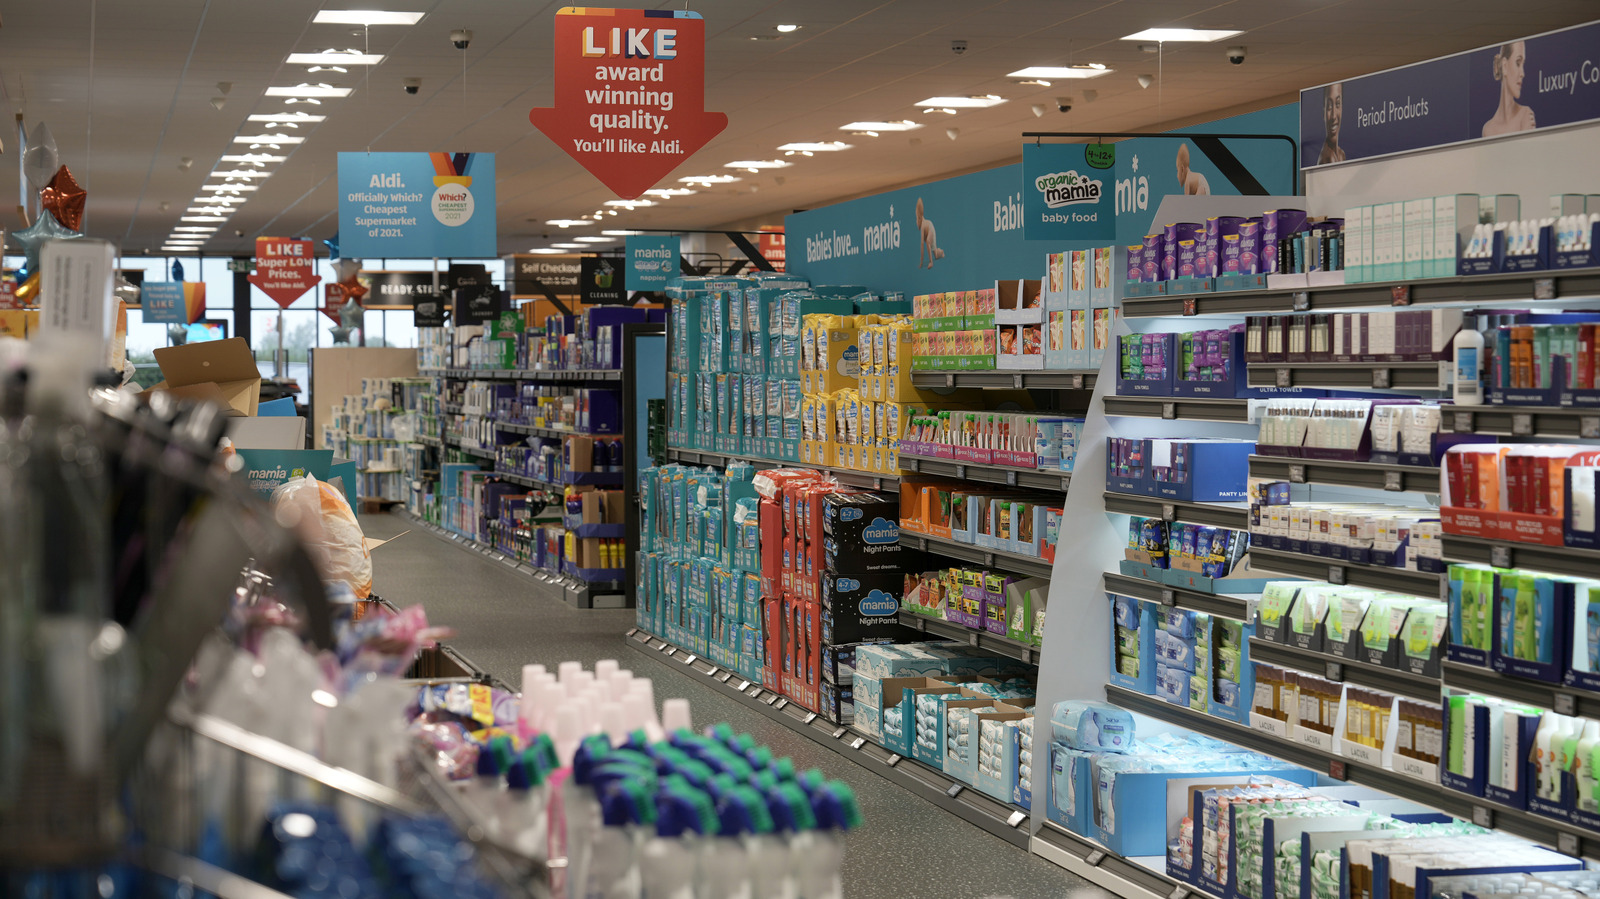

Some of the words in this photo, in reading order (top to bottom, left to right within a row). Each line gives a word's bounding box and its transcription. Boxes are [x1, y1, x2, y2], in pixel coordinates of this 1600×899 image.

[582, 26, 678, 60] LIKE
[595, 63, 664, 82] award
[1539, 69, 1578, 95] Luxury
[1581, 59, 1600, 85] Co
[585, 84, 673, 111] winning
[1357, 101, 1386, 128] Period
[1389, 95, 1429, 123] Products
[589, 109, 669, 135] quality.
[573, 138, 615, 153] You'll
[618, 138, 646, 153] like
[649, 139, 685, 154] Aldi.
[369, 172, 406, 188] Aldi.
[1037, 172, 1078, 191] organic
[1046, 176, 1099, 203] mamia
[348, 192, 389, 204] Officially
[390, 192, 423, 202] Which?
[438, 192, 467, 202] Which?
[364, 204, 408, 216] Cheapest
[444, 212, 461, 220] 2021
[354, 216, 417, 228] Supermarket
[1041, 212, 1070, 224] baby
[1071, 212, 1098, 222] food
[368, 228, 379, 238] of
[379, 228, 404, 238] 2021.
[863, 204, 901, 255] mamia
[266, 243, 304, 257] LIKE
[634, 244, 672, 259] mamia
[806, 231, 832, 263] Babies
[833, 229, 859, 258] love...
[257, 257, 288, 269] Super
[289, 258, 312, 267] LOW
[521, 262, 540, 274] Self
[268, 269, 302, 279] Prices.
[560, 276, 578, 285] Card
[640, 274, 666, 282] nappies
[149, 299, 175, 309] LIKE
[248, 465, 287, 479] mamia
[866, 524, 899, 539] mamia
[863, 545, 881, 554] Night
[862, 597, 896, 610] mamia
[859, 617, 877, 626] Night
[878, 617, 898, 625] Pants
[1258, 720, 1276, 732] LACURA
[1303, 733, 1321, 746] LACURA
[1350, 747, 1369, 760] LACURA
[1403, 762, 1424, 776] LACURA
